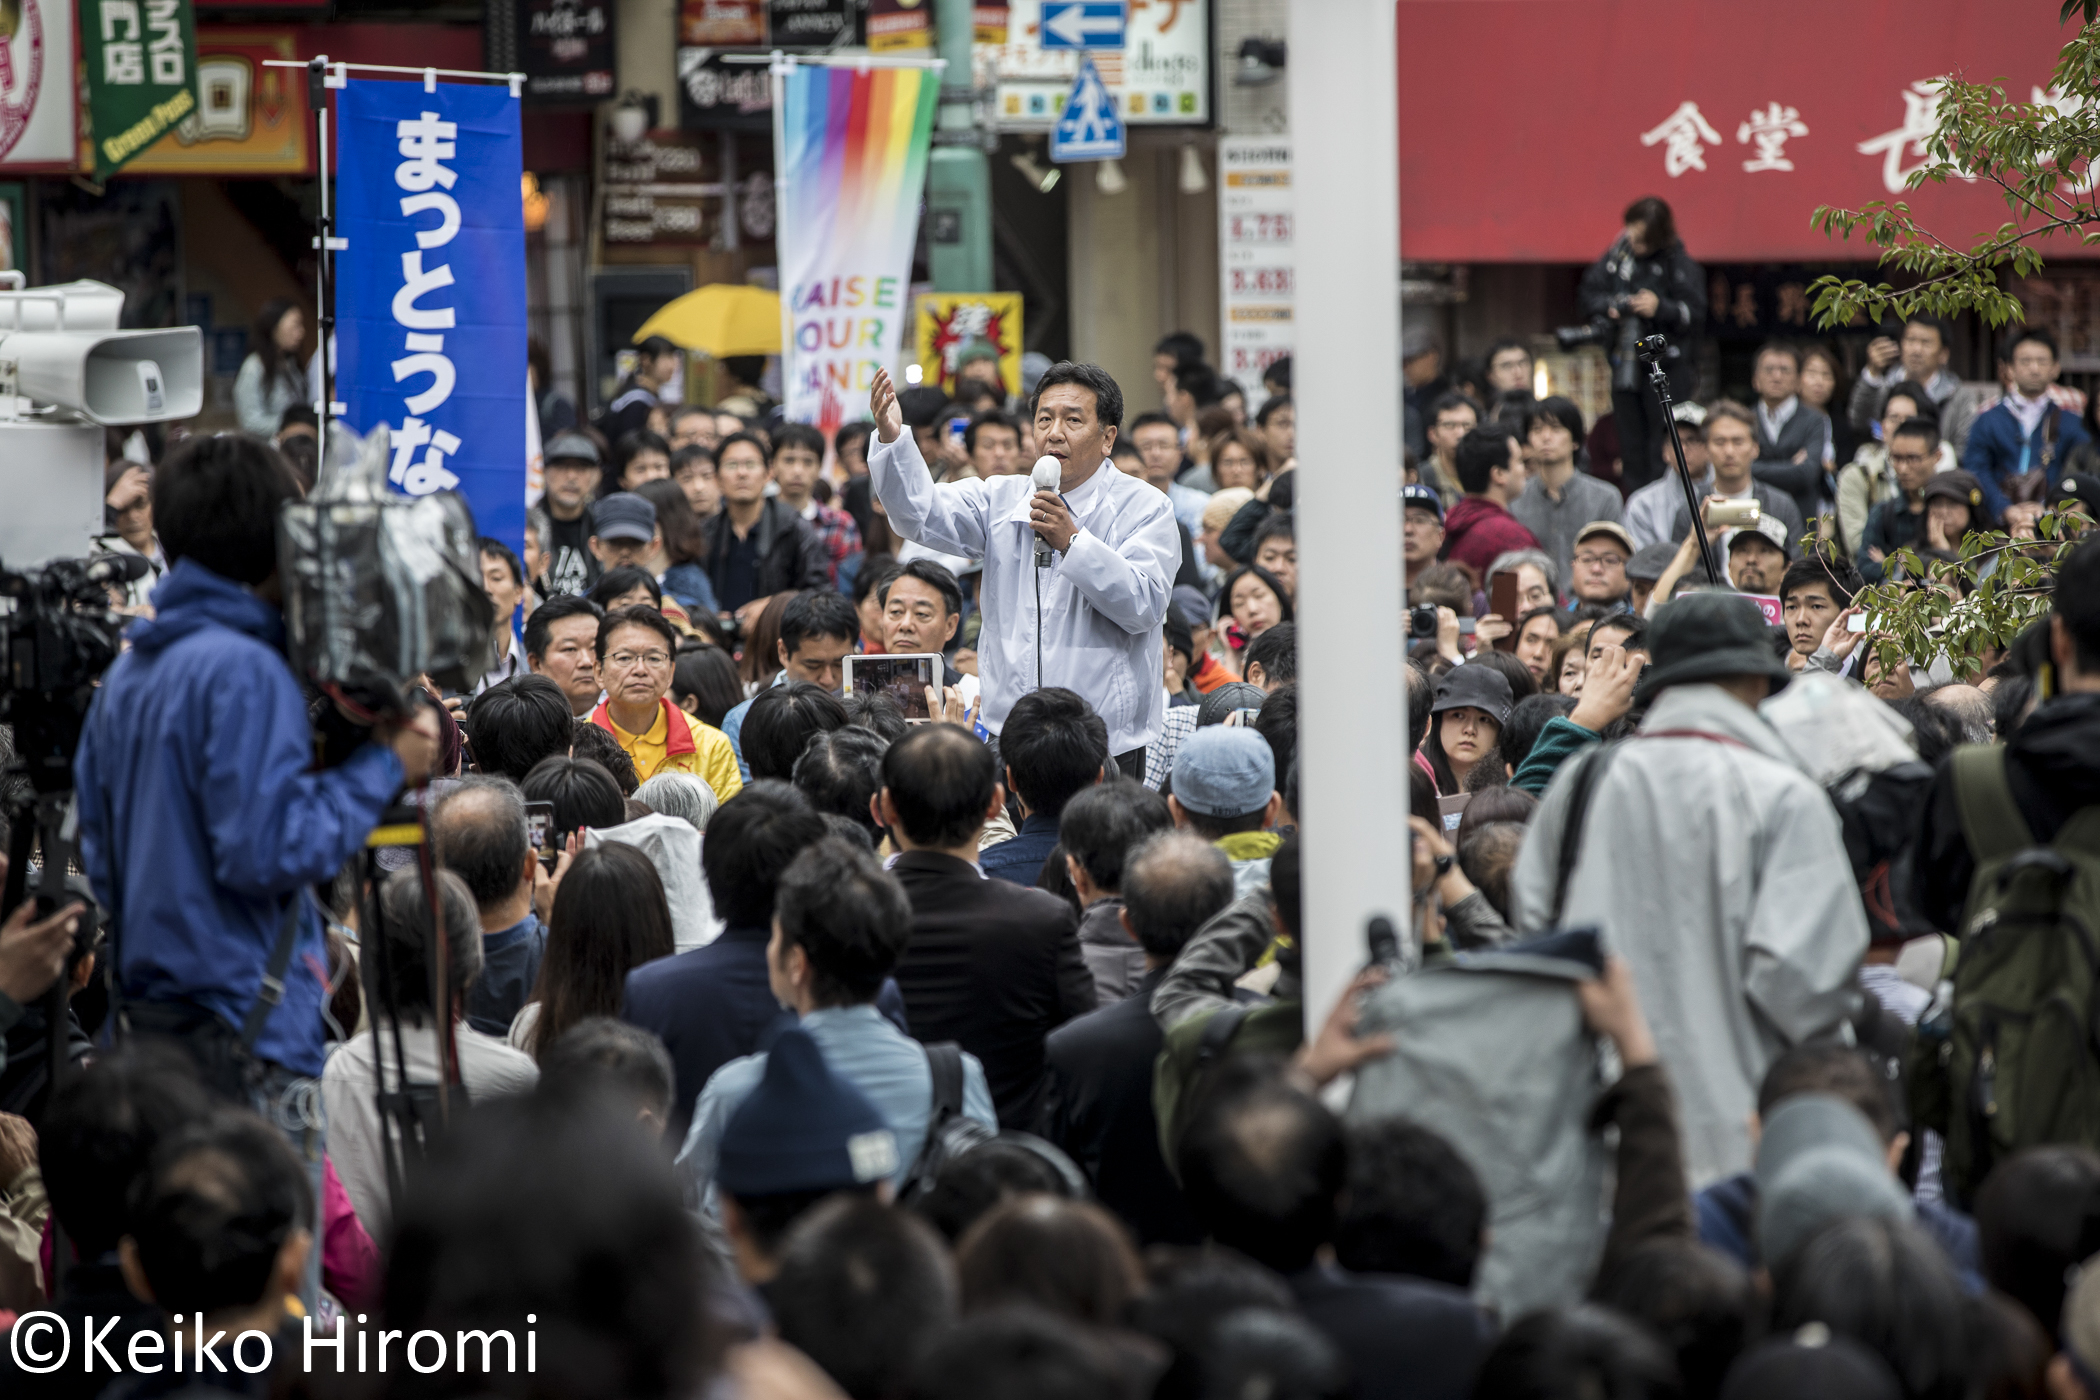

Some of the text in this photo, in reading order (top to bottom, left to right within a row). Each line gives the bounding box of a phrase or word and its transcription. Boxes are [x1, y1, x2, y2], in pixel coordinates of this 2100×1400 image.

[1639, 100, 1810, 178] 食堂
[389, 110, 463, 497] まっとうな
[795, 318, 884, 352] OUR
